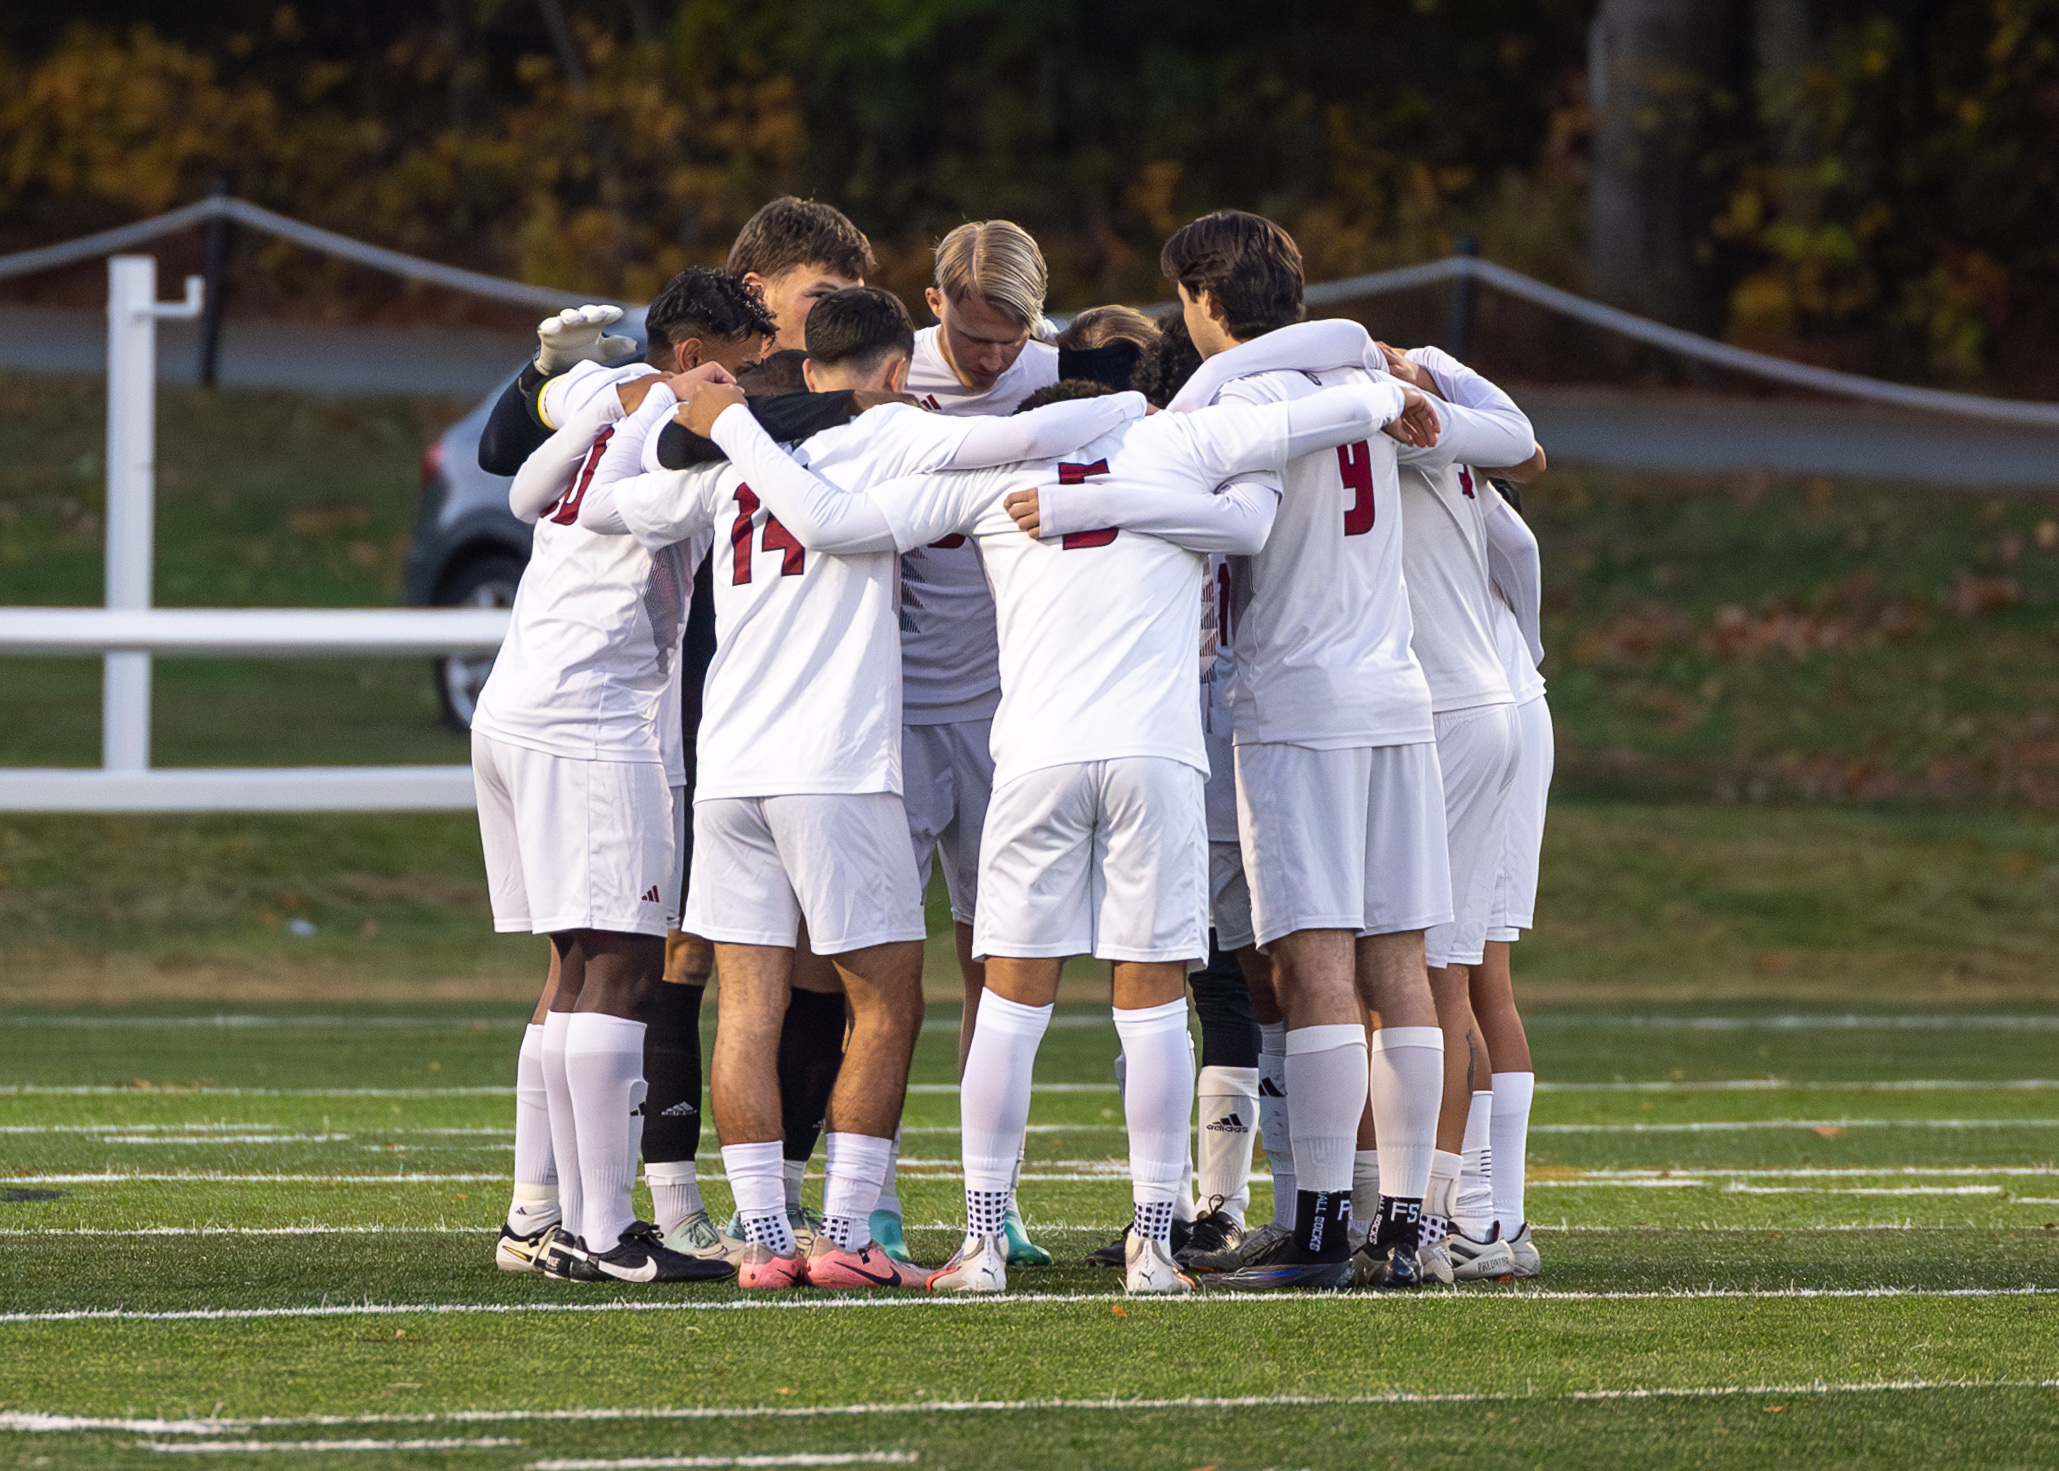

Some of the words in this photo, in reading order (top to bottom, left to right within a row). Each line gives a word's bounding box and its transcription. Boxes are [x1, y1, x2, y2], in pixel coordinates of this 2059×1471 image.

[1336, 439, 1375, 536] 9
[731, 481, 805, 586] 14
[1206, 1123, 1249, 1134] adidas
[1390, 1201, 1420, 1223] F5
[1309, 1215, 1325, 1252] SOCKS
